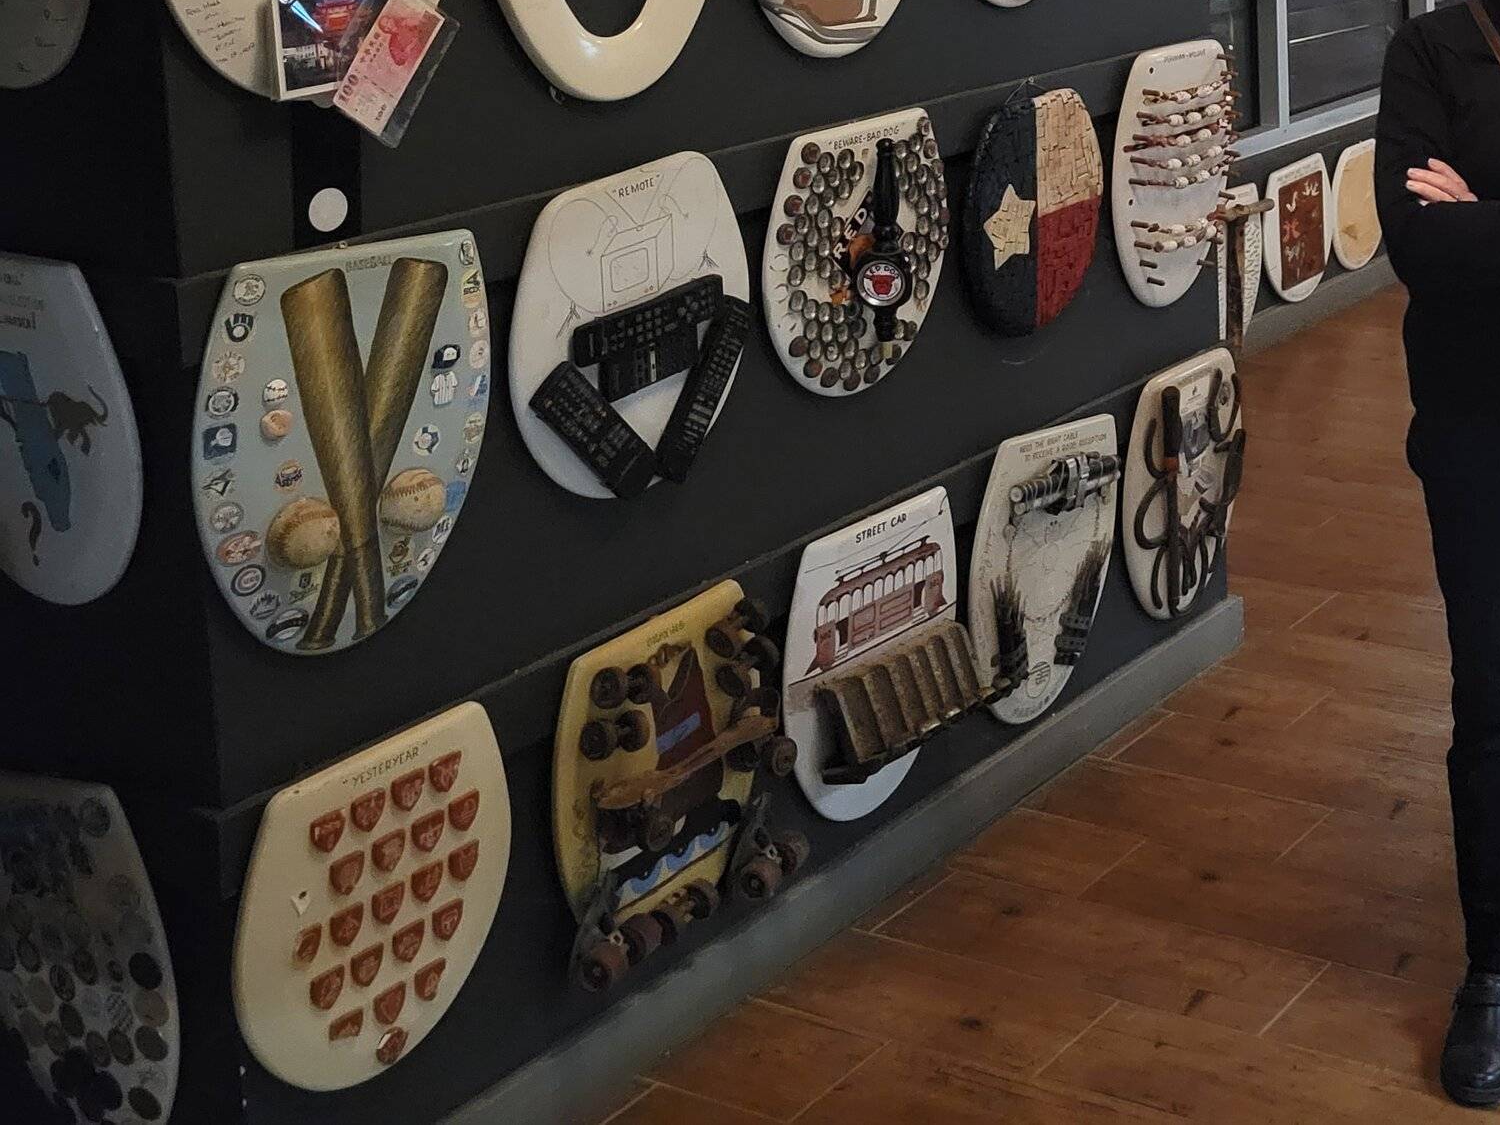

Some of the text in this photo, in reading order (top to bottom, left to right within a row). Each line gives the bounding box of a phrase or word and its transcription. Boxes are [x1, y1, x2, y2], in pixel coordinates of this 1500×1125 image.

[338, 74, 359, 104] 100
[833, 207, 868, 260] RED
[855, 513, 907, 544] STREET CAR
